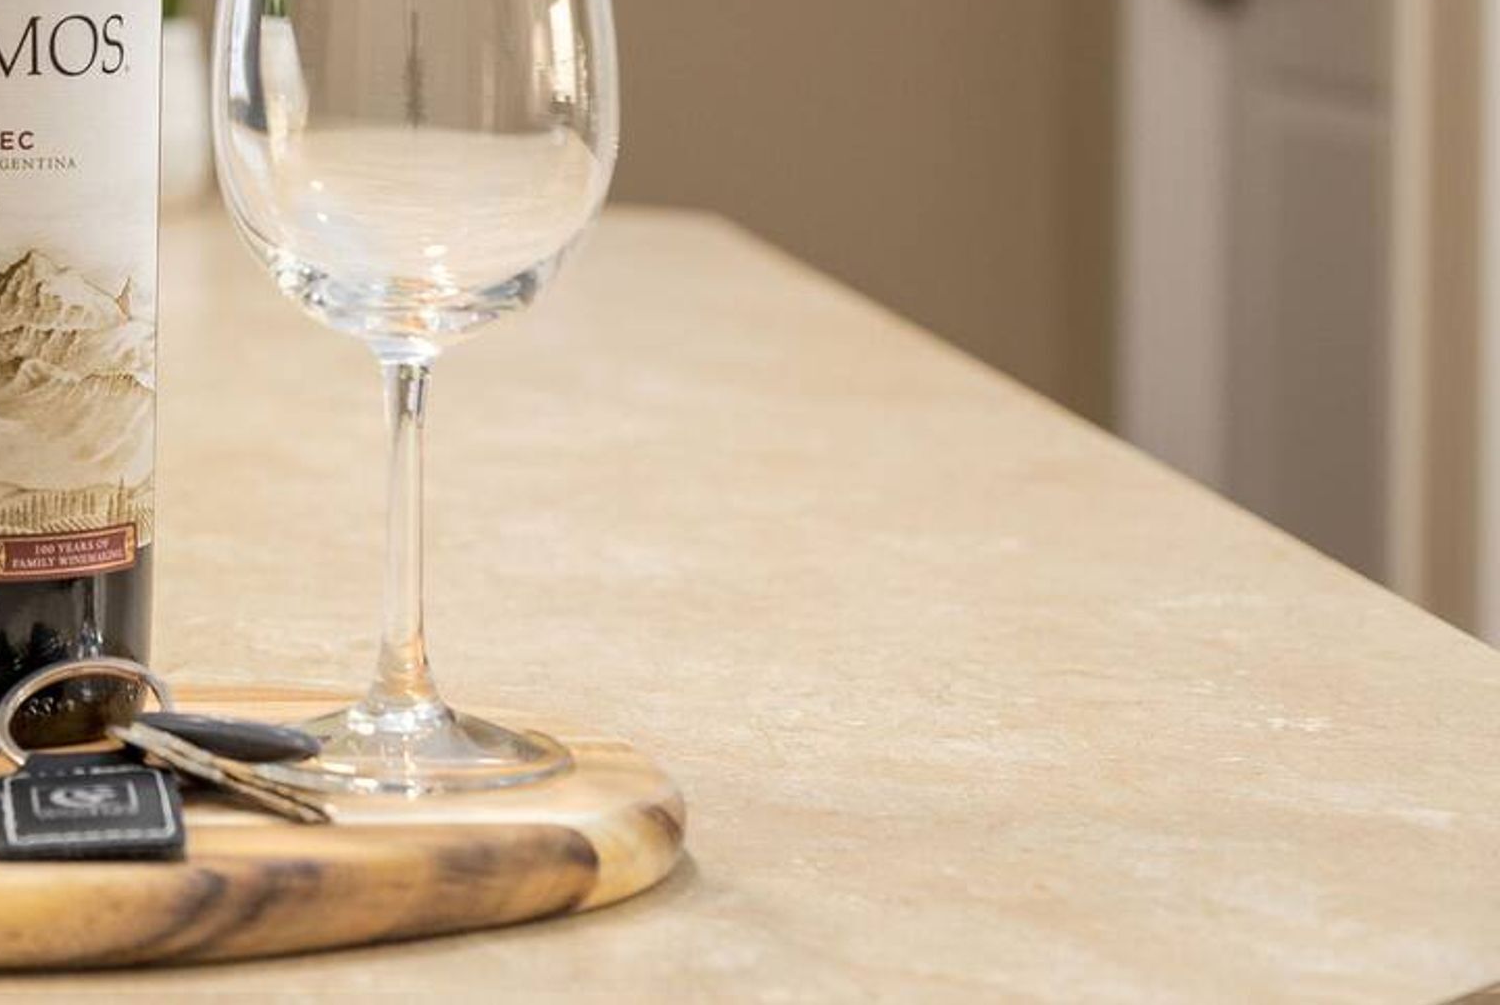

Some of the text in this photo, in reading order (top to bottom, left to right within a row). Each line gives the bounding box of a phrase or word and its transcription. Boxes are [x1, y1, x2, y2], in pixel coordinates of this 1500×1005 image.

[34, 538, 110, 555] 100 YEARS OF
[11, 556, 55, 569] FAMILY
